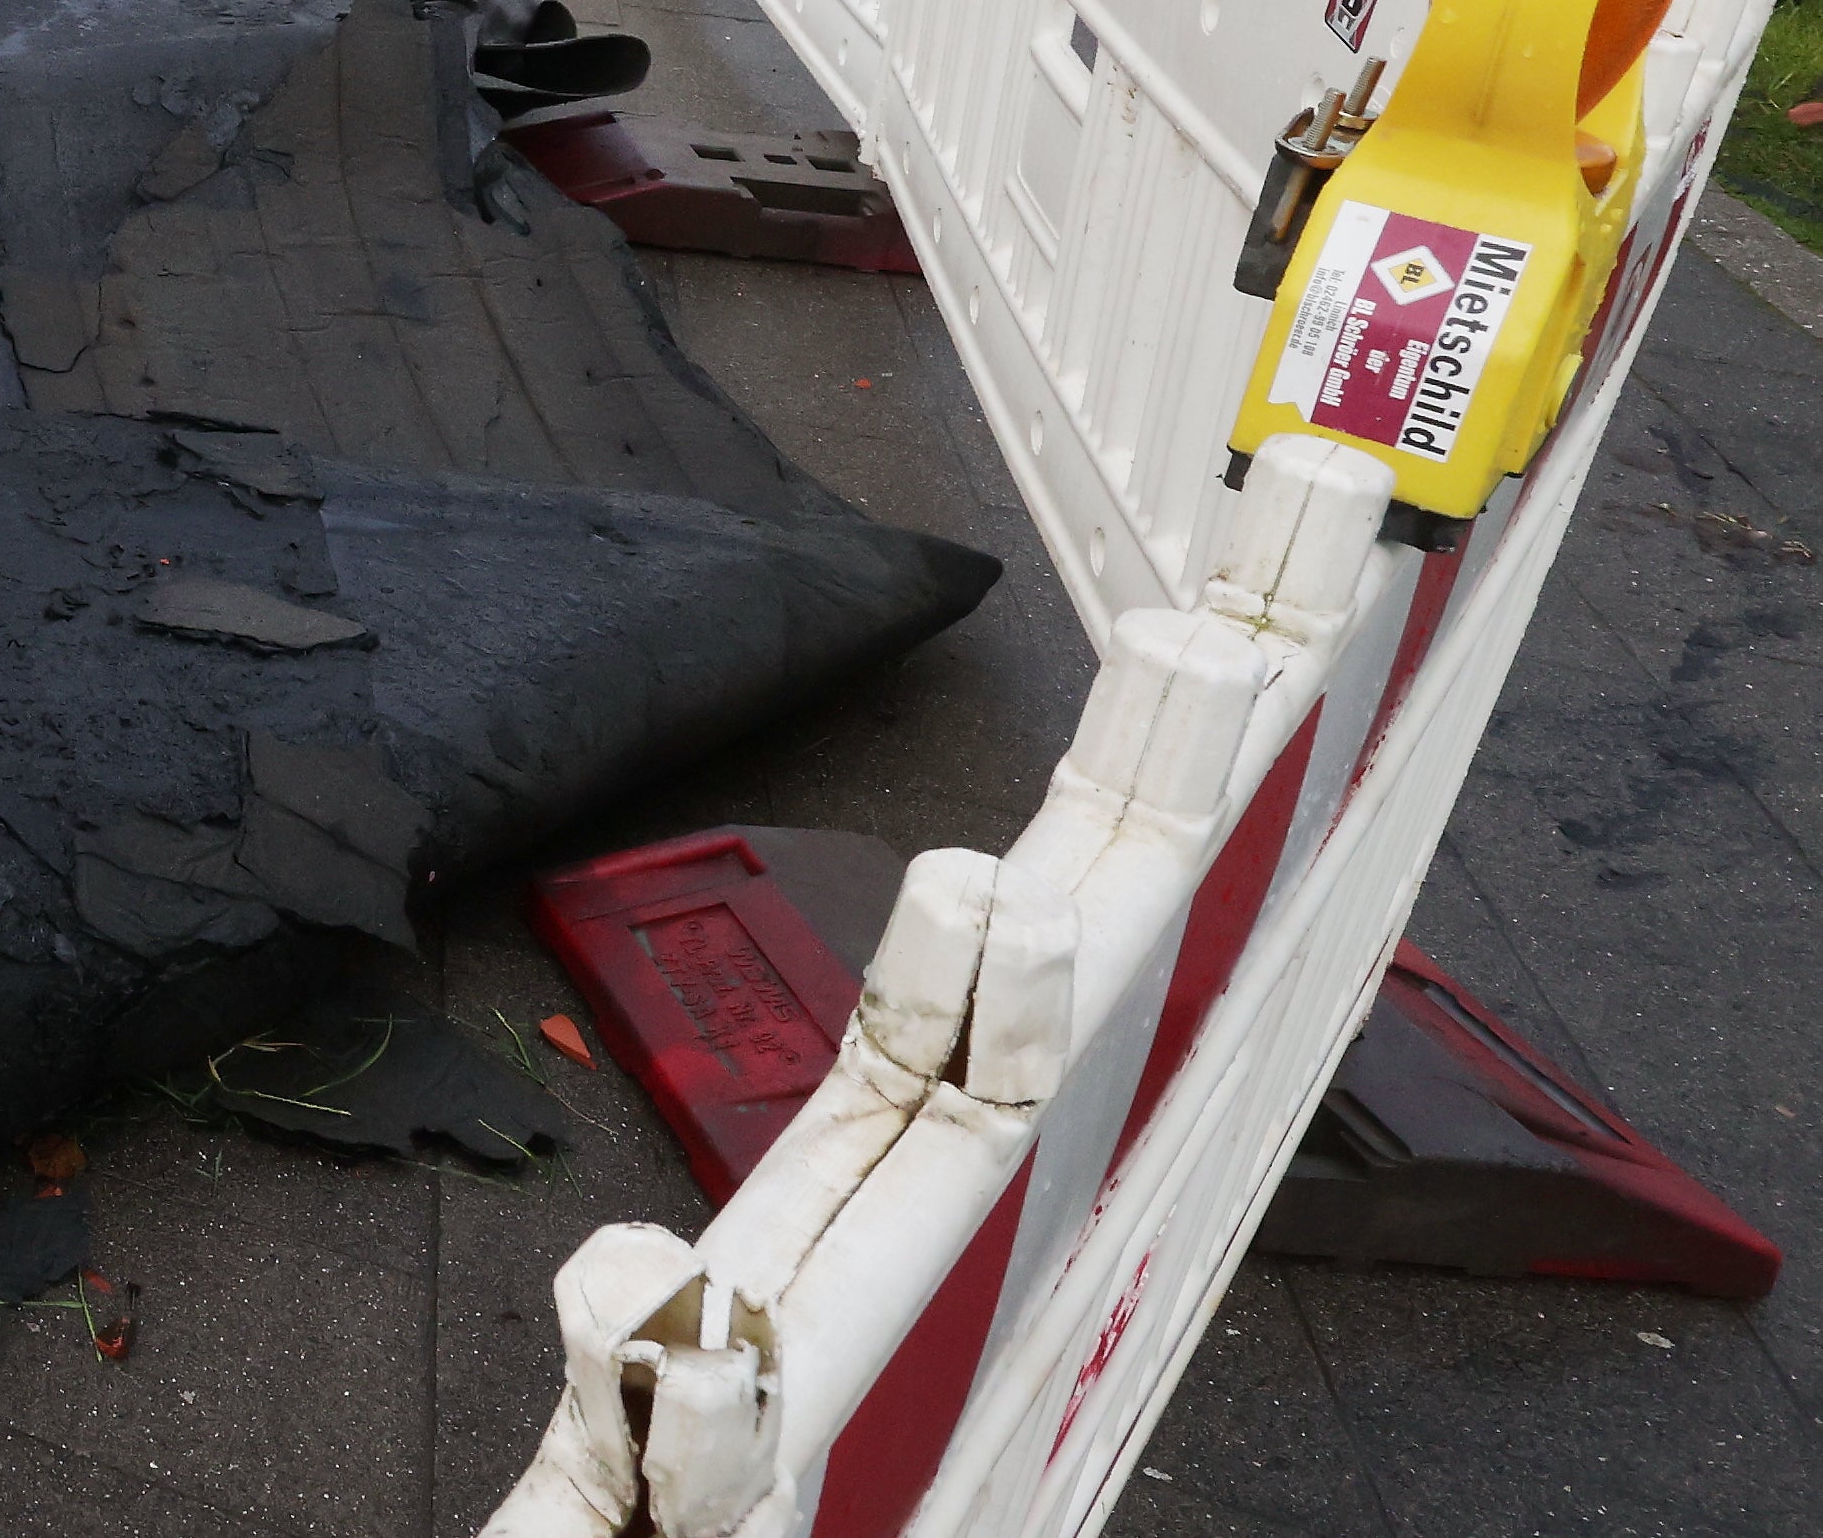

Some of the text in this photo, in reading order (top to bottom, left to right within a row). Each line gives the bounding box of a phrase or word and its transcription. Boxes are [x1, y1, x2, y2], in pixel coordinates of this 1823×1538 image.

[1401, 262, 1424, 285] BL
[1317, 296, 1378, 408] BL Schröer GmbH
[1365, 349, 1391, 375] der
[1389, 339, 1431, 400] Eigentum
[1402, 240, 1527, 458] Mietschild
